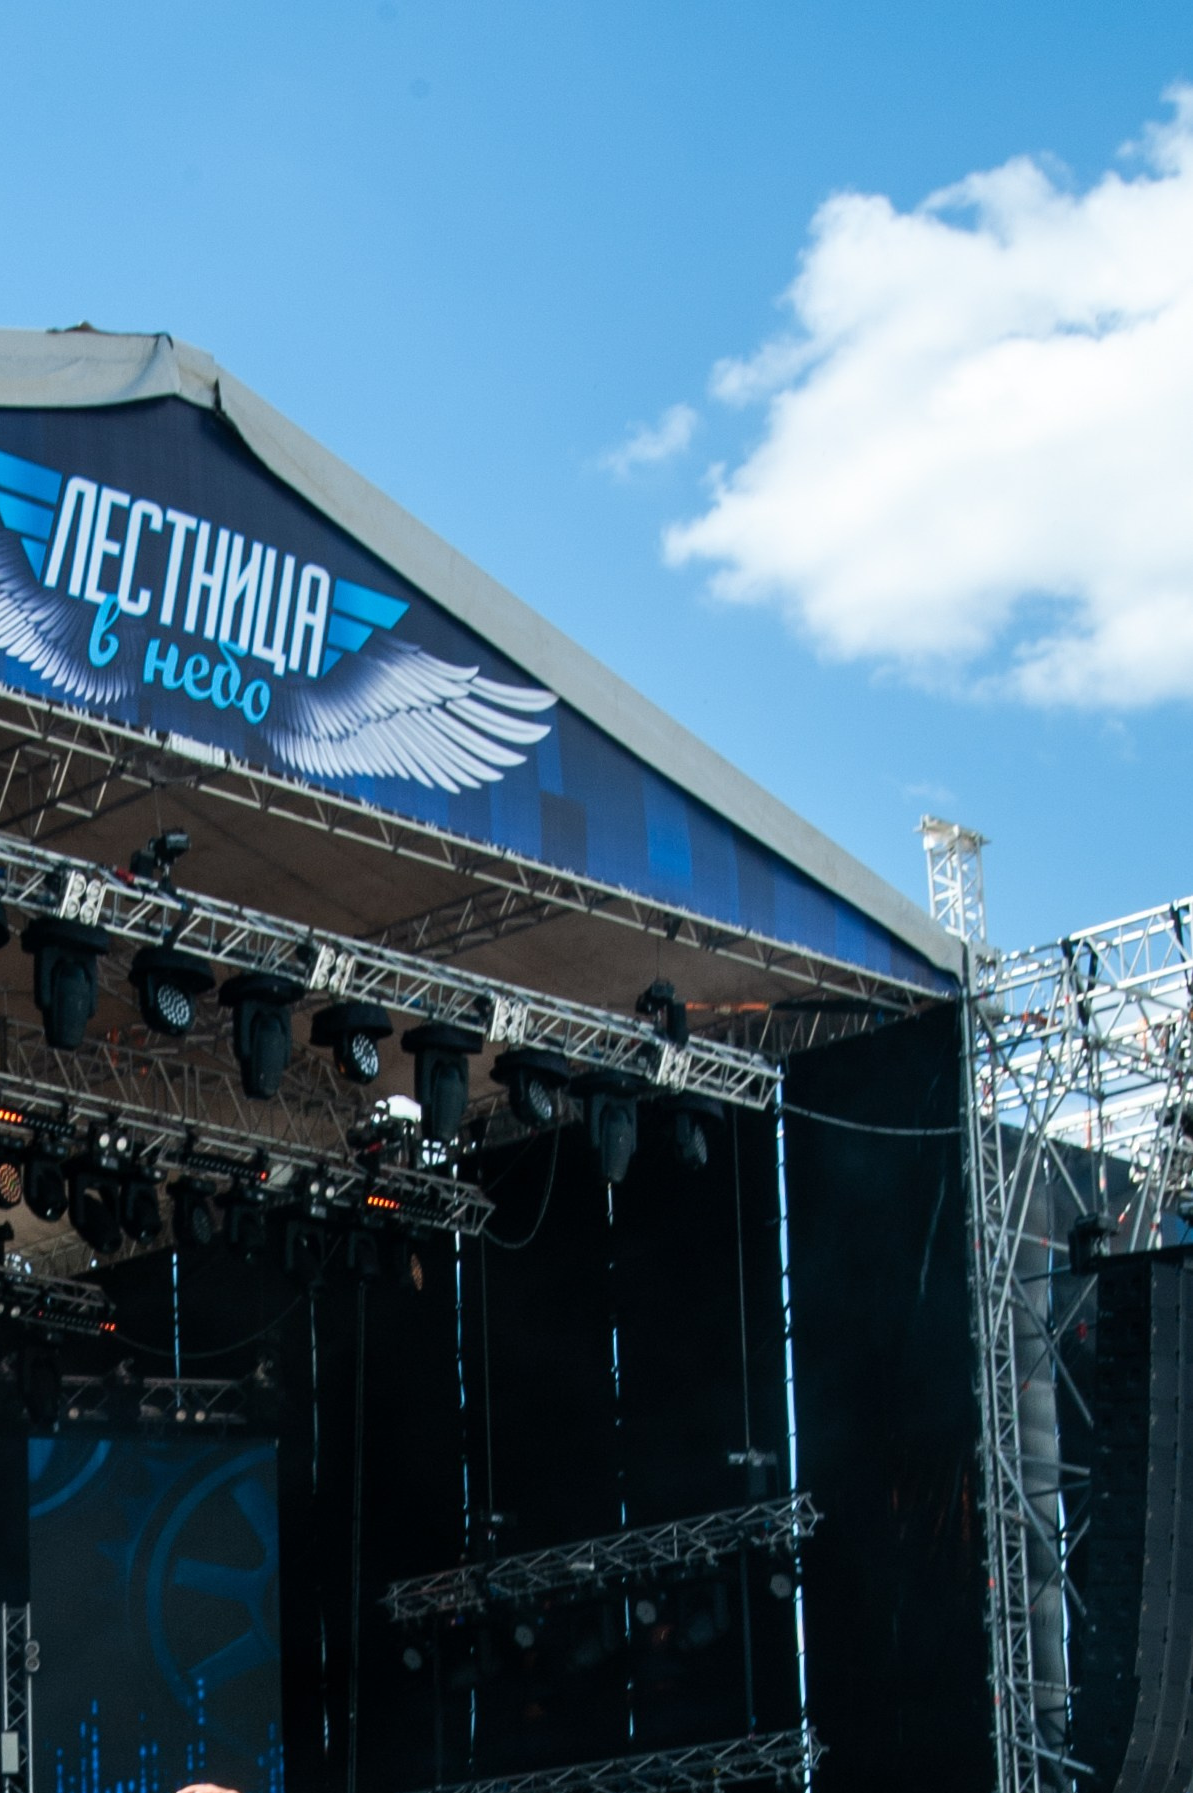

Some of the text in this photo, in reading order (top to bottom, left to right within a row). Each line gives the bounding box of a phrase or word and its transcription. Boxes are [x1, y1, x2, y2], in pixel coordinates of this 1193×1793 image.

[43, 475, 333, 679] ЛЕСТНИЦА
[88, 597, 273, 726] в небо
